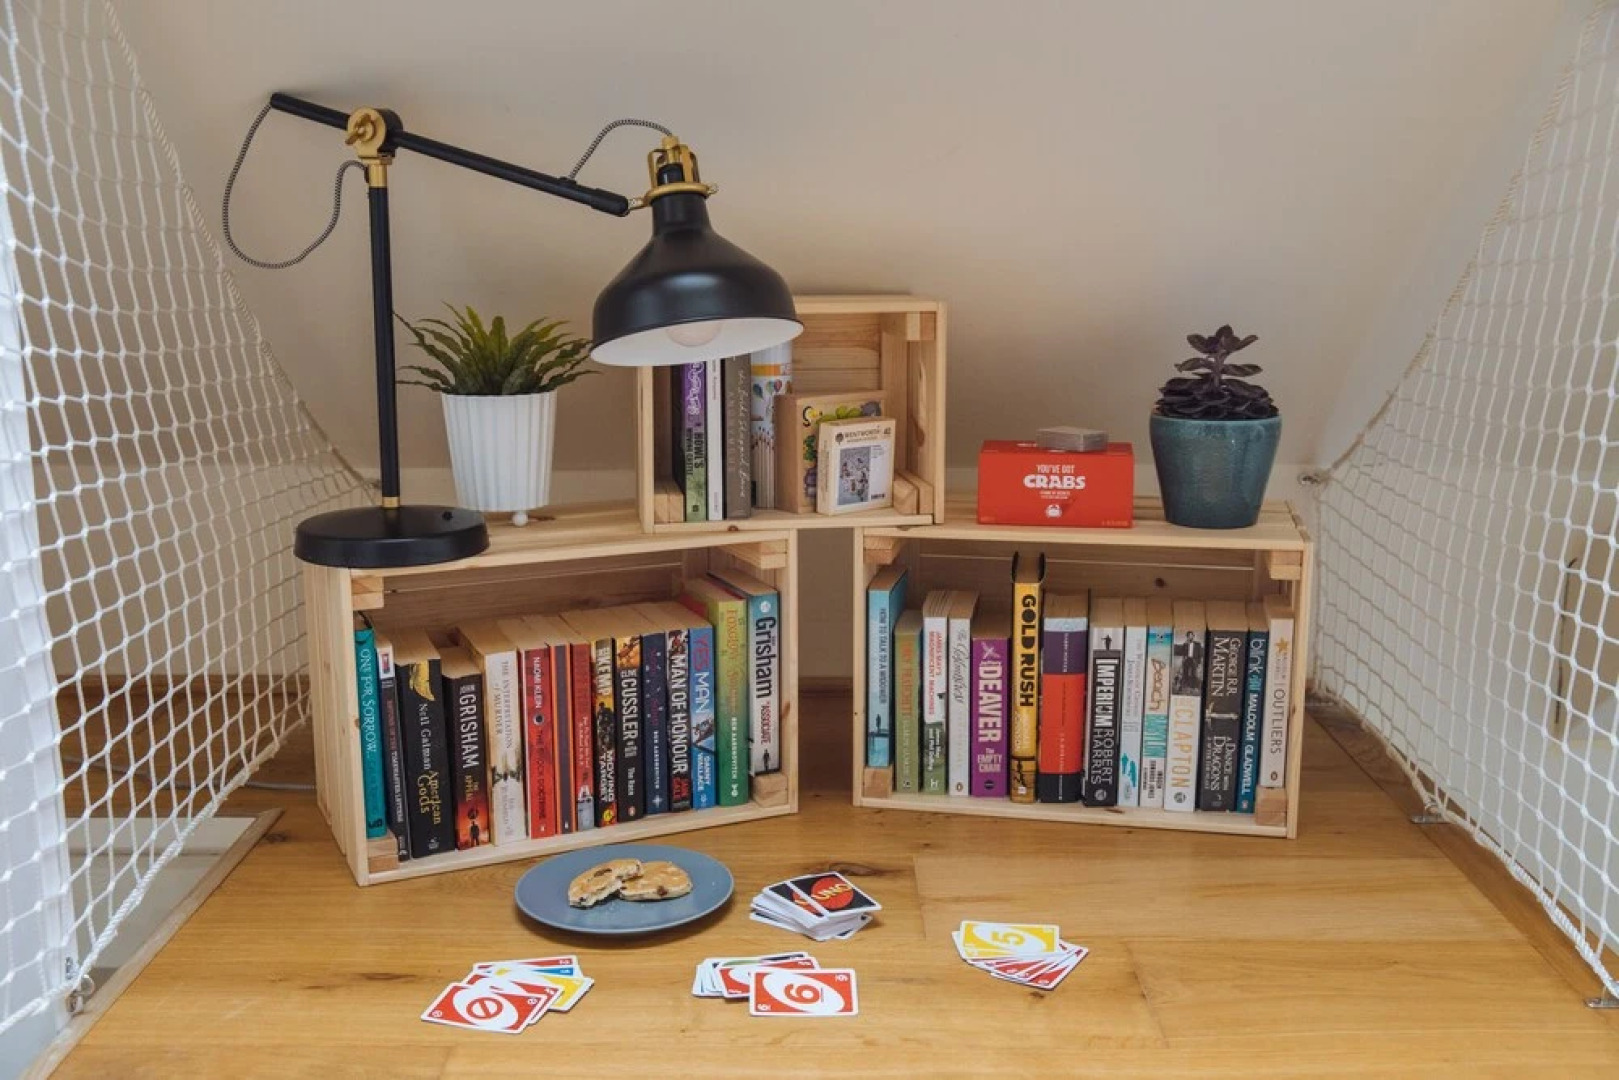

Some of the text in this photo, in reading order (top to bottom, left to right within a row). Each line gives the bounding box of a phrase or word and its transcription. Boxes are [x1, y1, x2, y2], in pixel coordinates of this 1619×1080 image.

[694, 432, 704, 468] HOWL'S
[1036, 464, 1075, 474] YOU'VE GOT
[1023, 474, 1086, 490] CRABS
[878, 626, 888, 635] TO
[878, 636, 888, 653] TALK
[935, 632, 943, 654] JAMES
[1019, 594, 1037, 707] GOLD RUSH
[360, 649, 372, 672] ONE
[598, 657, 612, 697] KEMP
[692, 633, 711, 713] YES MAN
[755, 617, 777, 699] Grisham
[878, 655, 888, 664] TO
[928, 631, 936, 678] MAGNIFICENT
[1211, 637, 1231, 697] MARTIN
[1226, 637, 1243, 676] GEORGE
[1247, 638, 1267, 674] blink
[361, 676, 374, 698] FOR
[532, 656, 544, 709] NAOMI KLEIN
[978, 667, 1003, 743] DEAVER
[1095, 658, 1119, 728] IMPERIUM
[1148, 658, 1167, 712] Beach
[459, 694, 480, 769] GRISHAM
[493, 693, 504, 736] MURDER
[502, 680, 514, 750] INTERPRETATION
[621, 677, 639, 741] CUSSLER
[671, 653, 689, 775] MAN OF HONOUR
[760, 706, 772, 745] ASSOCIATE
[1245, 693, 1259, 741] MALCOLM
[1269, 689, 1287, 755] OUTLIERS
[419, 703, 432, 770] Neil Gaiman
[1090, 728, 1104, 785] HARRIS
[1101, 728, 1115, 785] ROBERT
[1144, 714, 1169, 758] BABYLON
[1170, 708, 1195, 788] CLAPTON
[1223, 743, 1237, 775] DANCE
[599, 752, 608, 802] TARGET
[606, 749, 616, 802] MOVING
[697, 752, 706, 792] WALLACE
[703, 755, 712, 785] DANNY
[1210, 736, 1227, 791] DRAGONS
[1241, 744, 1255, 796] GLADWELL
[417, 775, 432, 814] Gods
[428, 771, 443, 824] American
[810, 883, 852, 901] UNO
[991, 930, 1025, 947] 5
[784, 983, 822, 1006] 6
